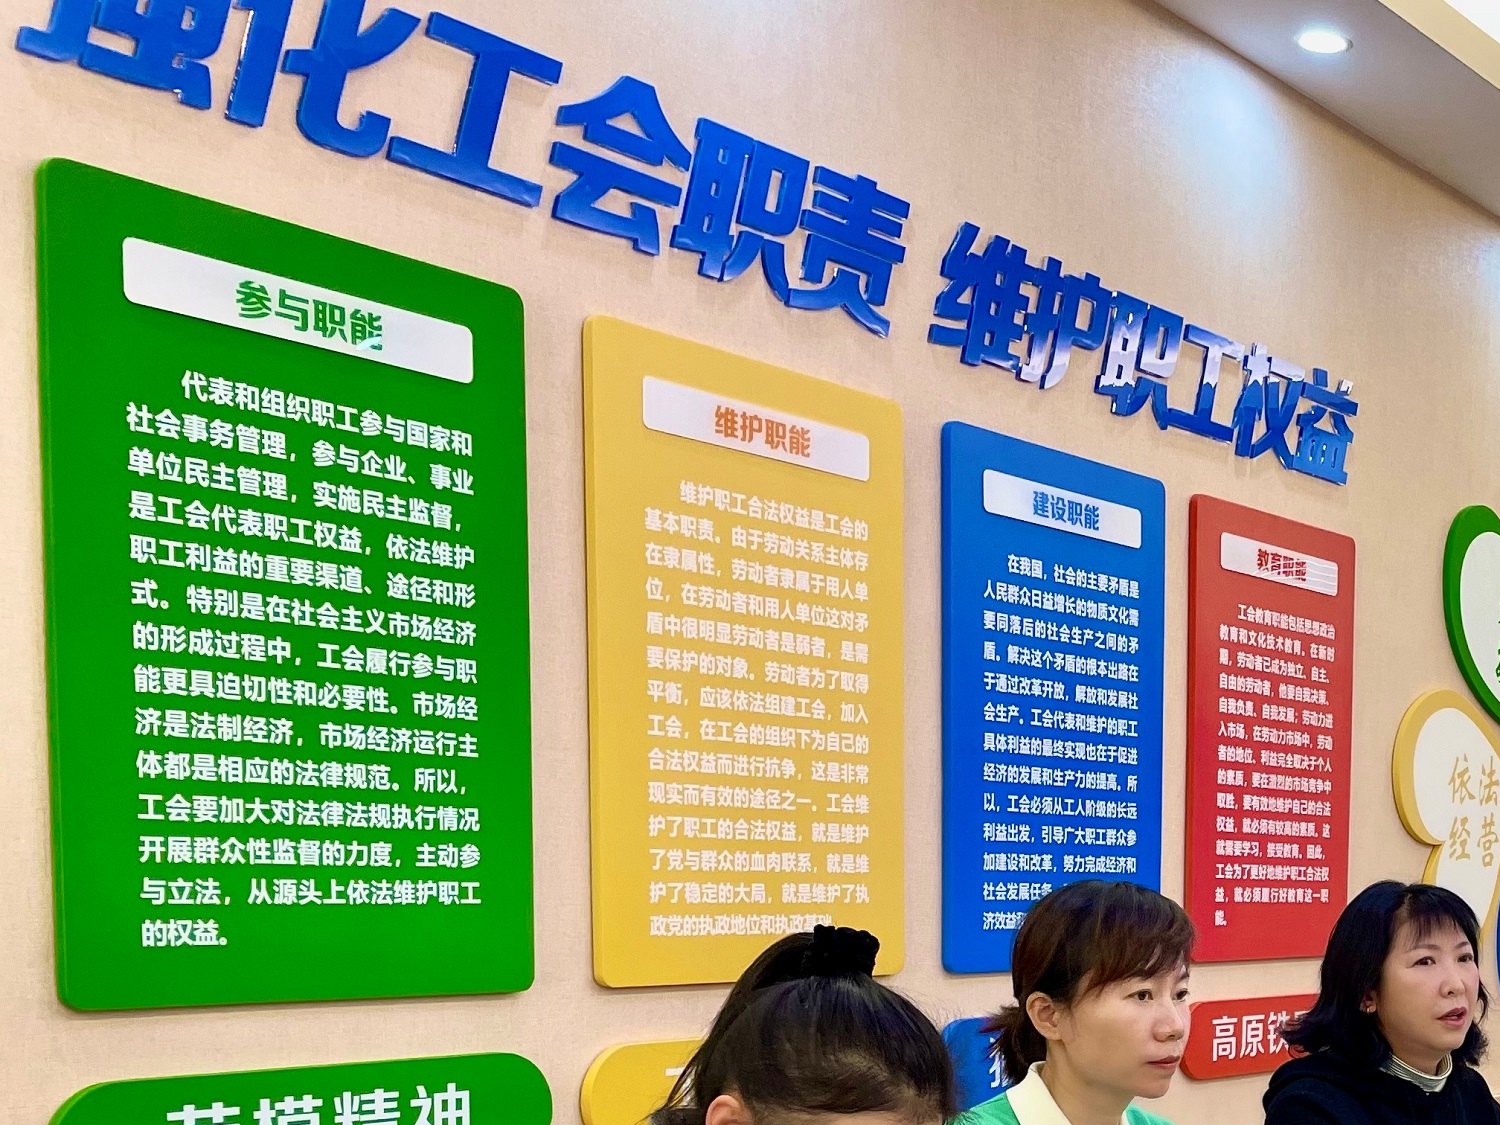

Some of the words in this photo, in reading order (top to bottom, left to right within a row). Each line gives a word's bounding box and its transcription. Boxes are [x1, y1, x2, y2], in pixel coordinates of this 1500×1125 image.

[236, 280, 383, 351] 参与职能
[928, 222, 1359, 485] 维护职工权益
[182, 370, 472, 456] 代表和组织职工参与国家和
[715, 405, 811, 458] 维护职能
[127, 402, 473, 495] 社会事务管理，参与企业、事业
[128, 447, 460, 531] 单位民主管理，实施民主监督，
[1033, 491, 1100, 531] 建设职能
[129, 491, 474, 569] 是工会代表职工权益，依法维护
[130, 535, 475, 608] 职工利益的重要渠道、途径和形
[131, 578, 476, 646] 式。特别是在社会主义市场经济
[133, 621, 477, 683] 的形成过程中，工会履行参与职
[134, 664, 478, 720] 能更具迫切性和必要性。市场经
[135, 707, 478, 757] 济是法制经济，市场经济运行主
[136, 750, 465, 794] 体都是相应的法律规范。所以，
[1448, 754, 1500, 807] 依法
[138, 794, 480, 831] 工会要加大对法律法规执行情况
[139, 836, 480, 868] 开展群众性监督的力度，主动参
[1448, 813, 1500, 868] 经营
[140, 877, 481, 905] 与立法，从源头上依法维护职工
[142, 919, 227, 946] 的权益。
[1212, 1010, 1311, 1062] 高原铁
